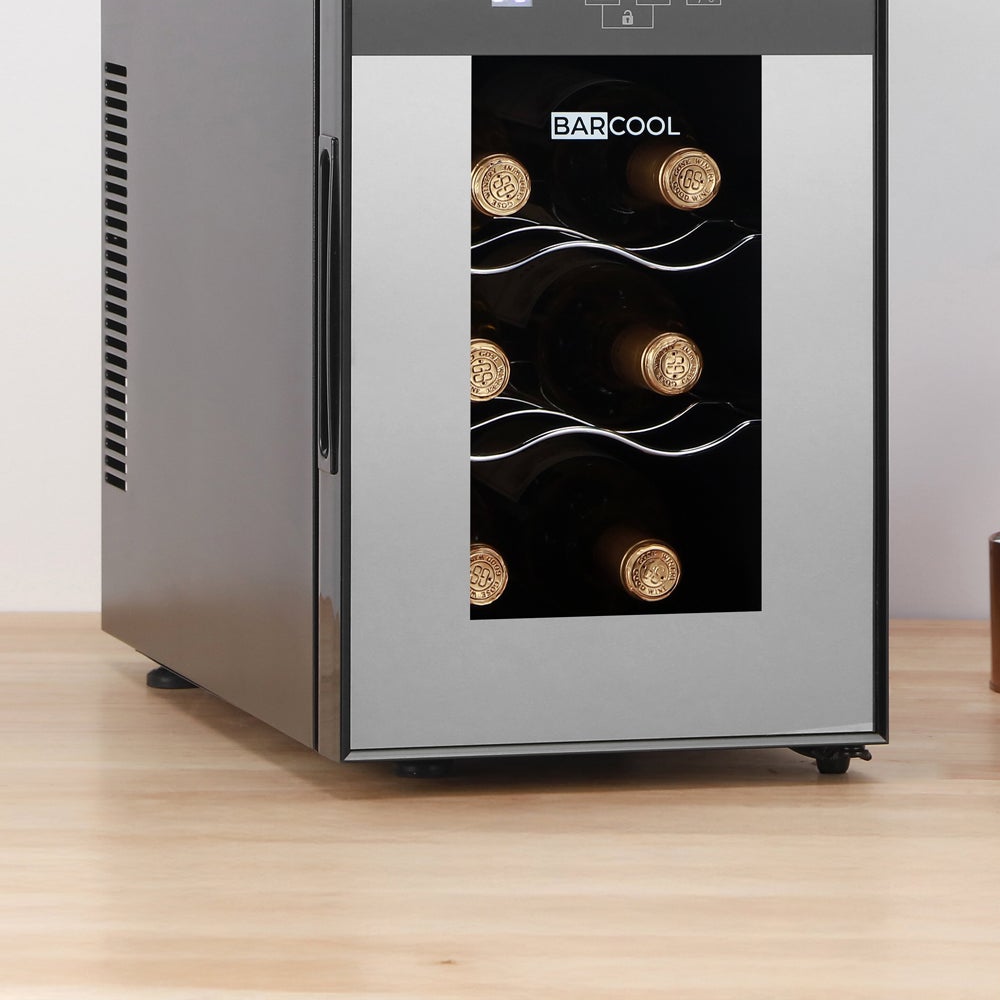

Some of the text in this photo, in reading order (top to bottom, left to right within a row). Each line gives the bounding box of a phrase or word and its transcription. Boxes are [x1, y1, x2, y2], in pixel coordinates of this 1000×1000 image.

[552, 115, 681, 137] BARCOOL
[683, 169, 703, 190] GS
[695, 158, 715, 183] WINERY
[493, 175, 515, 198] GS
[672, 181, 690, 201] GOOD
[472, 363, 493, 383] GS
[486, 556, 501, 577] GOOD
[481, 582, 499, 598] GOSE
